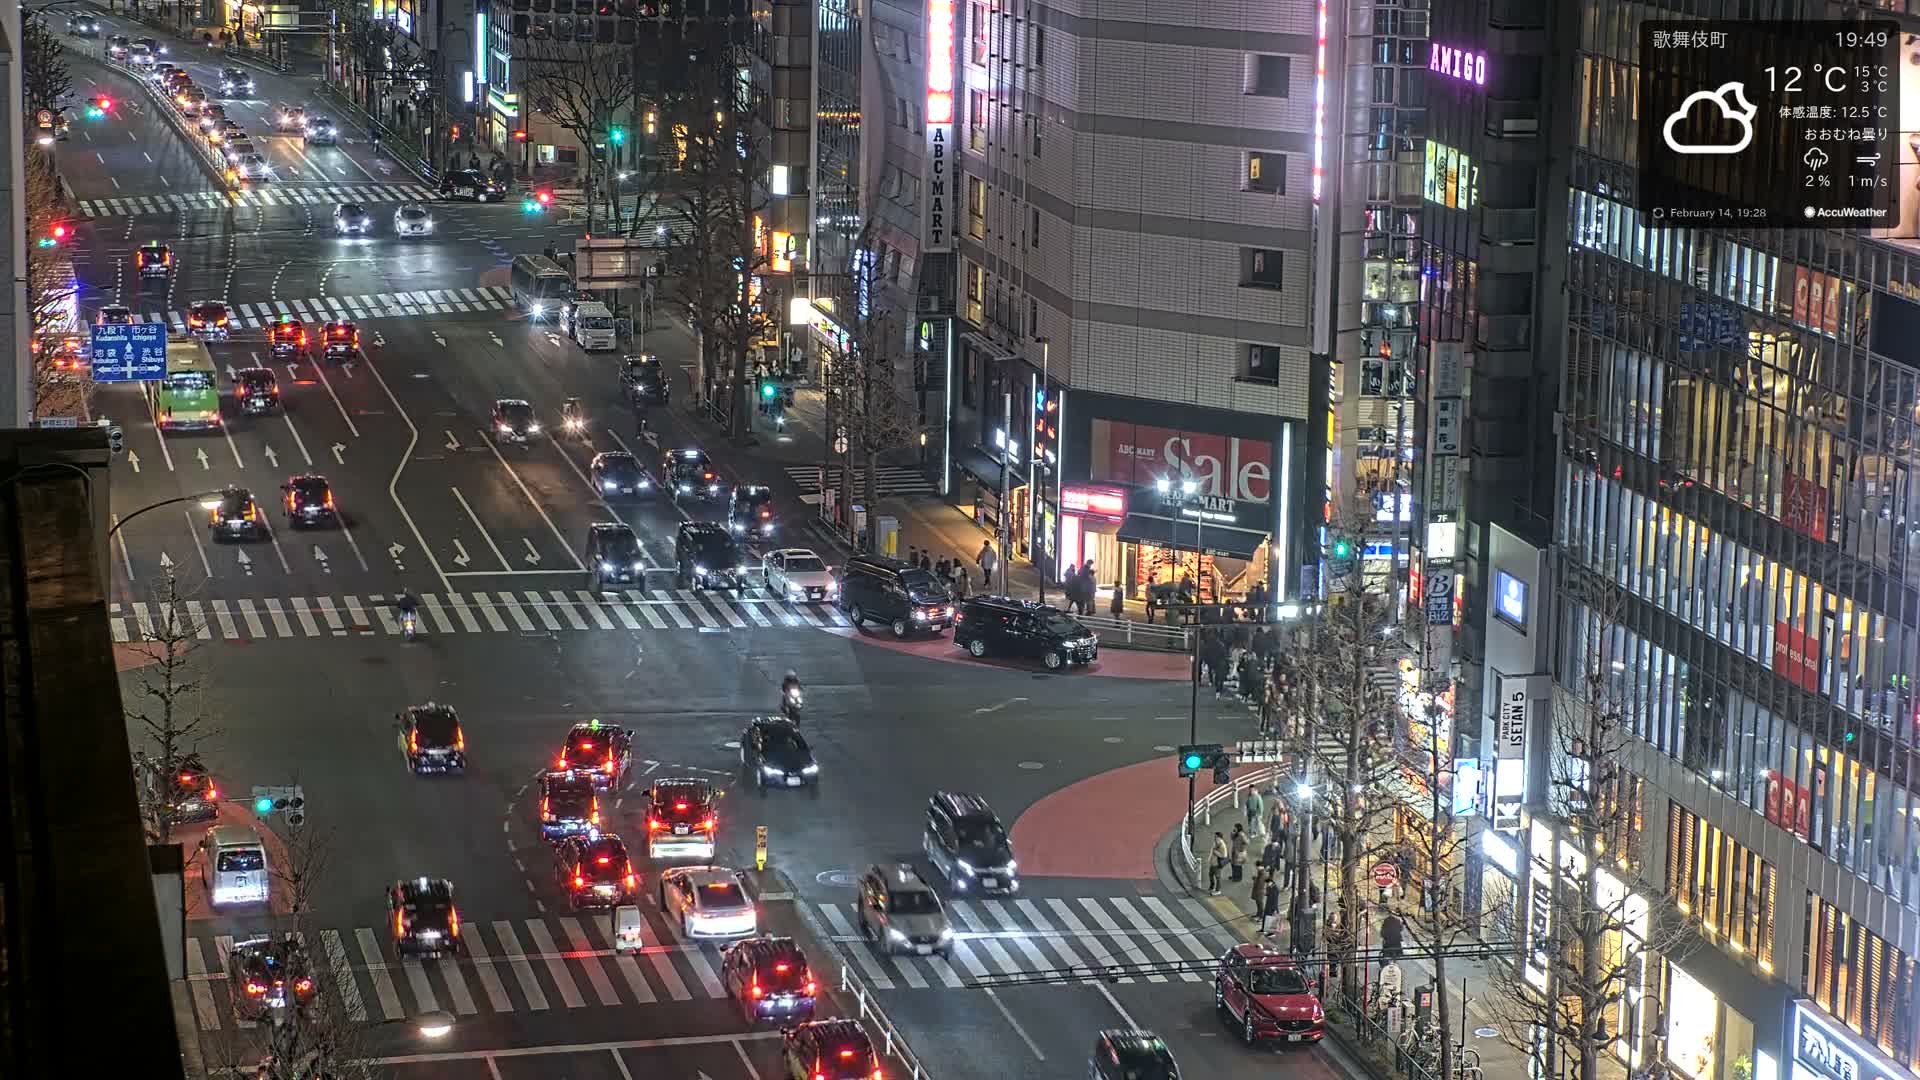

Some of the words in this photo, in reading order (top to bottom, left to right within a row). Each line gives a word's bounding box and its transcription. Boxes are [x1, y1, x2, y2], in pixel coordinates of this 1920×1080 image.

[1430, 43, 1486, 85] AMIGO
[98, 325, 126, 335] 九段下
[94, 348, 117, 358] 池袋
[141, 347, 164, 357] 渋谷
[141, 356, 165, 364] Shibuya
[1164, 436, 1271, 504] Sale
[1512, 691, 1525, 702] 5
[1503, 702, 1511, 719] CITY
[1502, 722, 1510, 740] PARK
[1510, 706, 1524, 746] ISETAN
